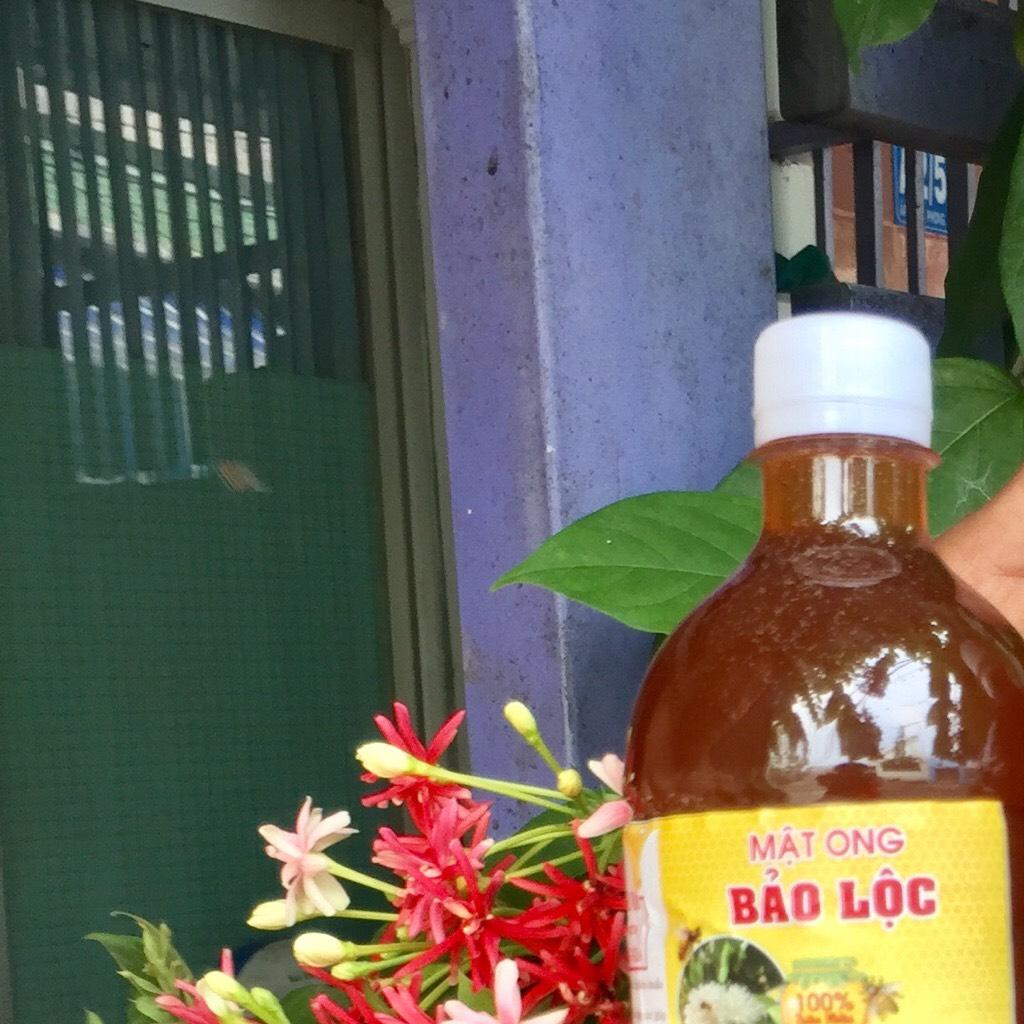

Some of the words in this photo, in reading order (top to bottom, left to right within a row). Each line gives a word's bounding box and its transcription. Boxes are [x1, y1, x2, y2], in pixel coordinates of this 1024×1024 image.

[749, 826, 815, 864] MẬT
[826, 827, 905, 856] ONG
[729, 868, 821, 925] BẢO
[840, 868, 937, 928] LỘC
[796, 992, 855, 1012] 100%
